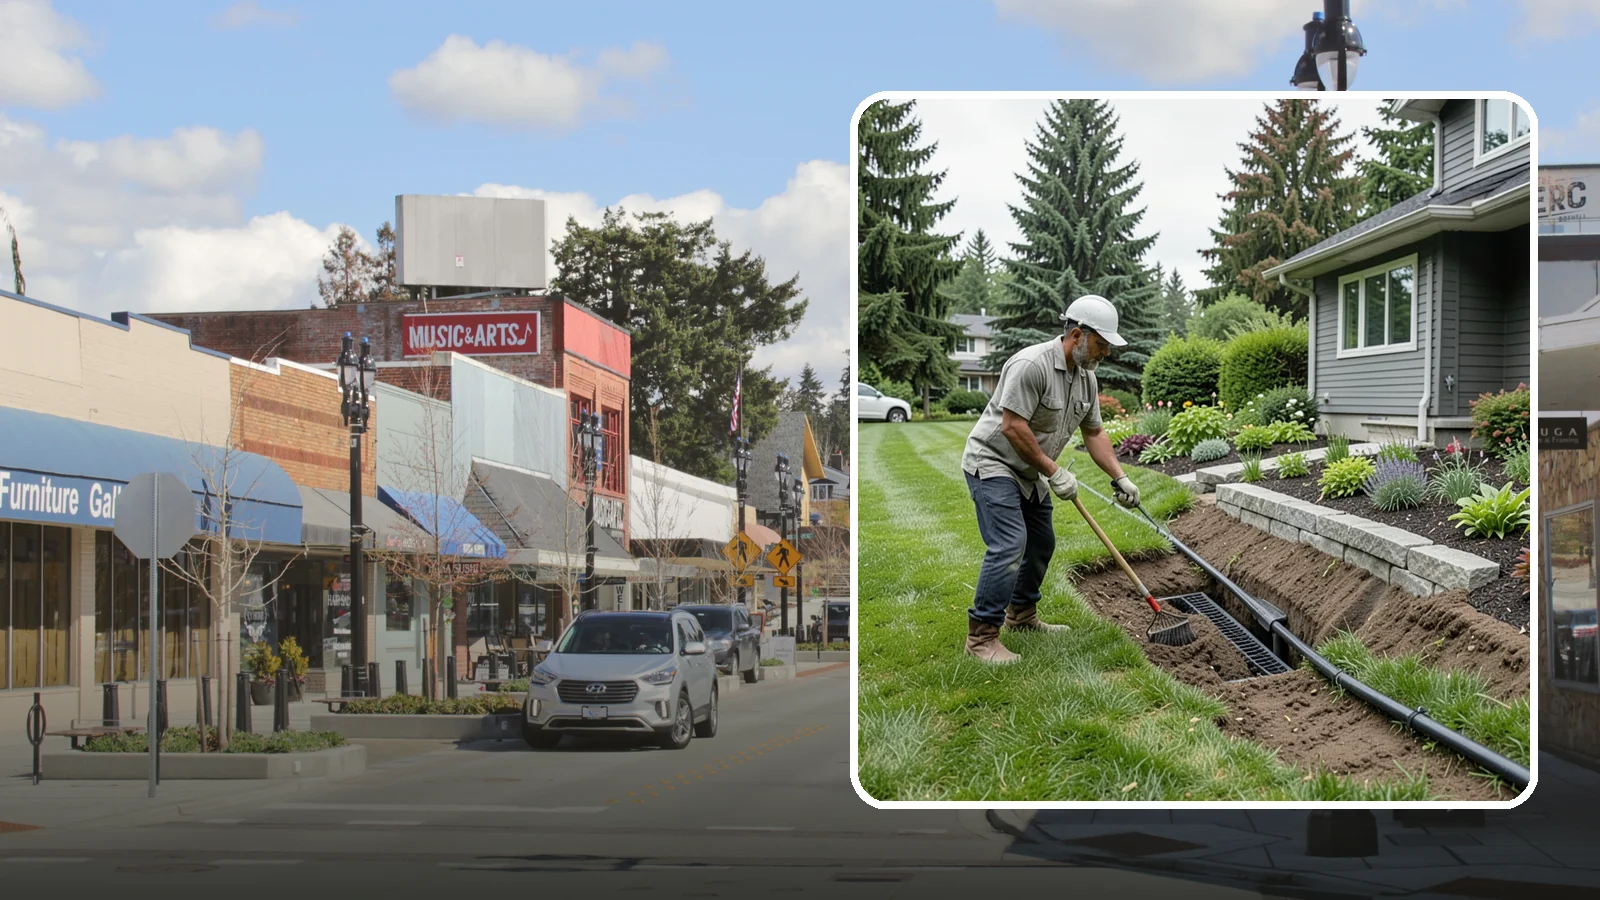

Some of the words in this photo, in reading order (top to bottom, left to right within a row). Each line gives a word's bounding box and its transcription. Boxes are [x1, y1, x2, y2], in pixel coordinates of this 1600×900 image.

[409, 323, 519, 349] MUSIC&ARTS
[0, 472, 79, 516] Furniture
[89, 482, 122, 519] Gal
[454, 562, 479, 574] SUSHI
